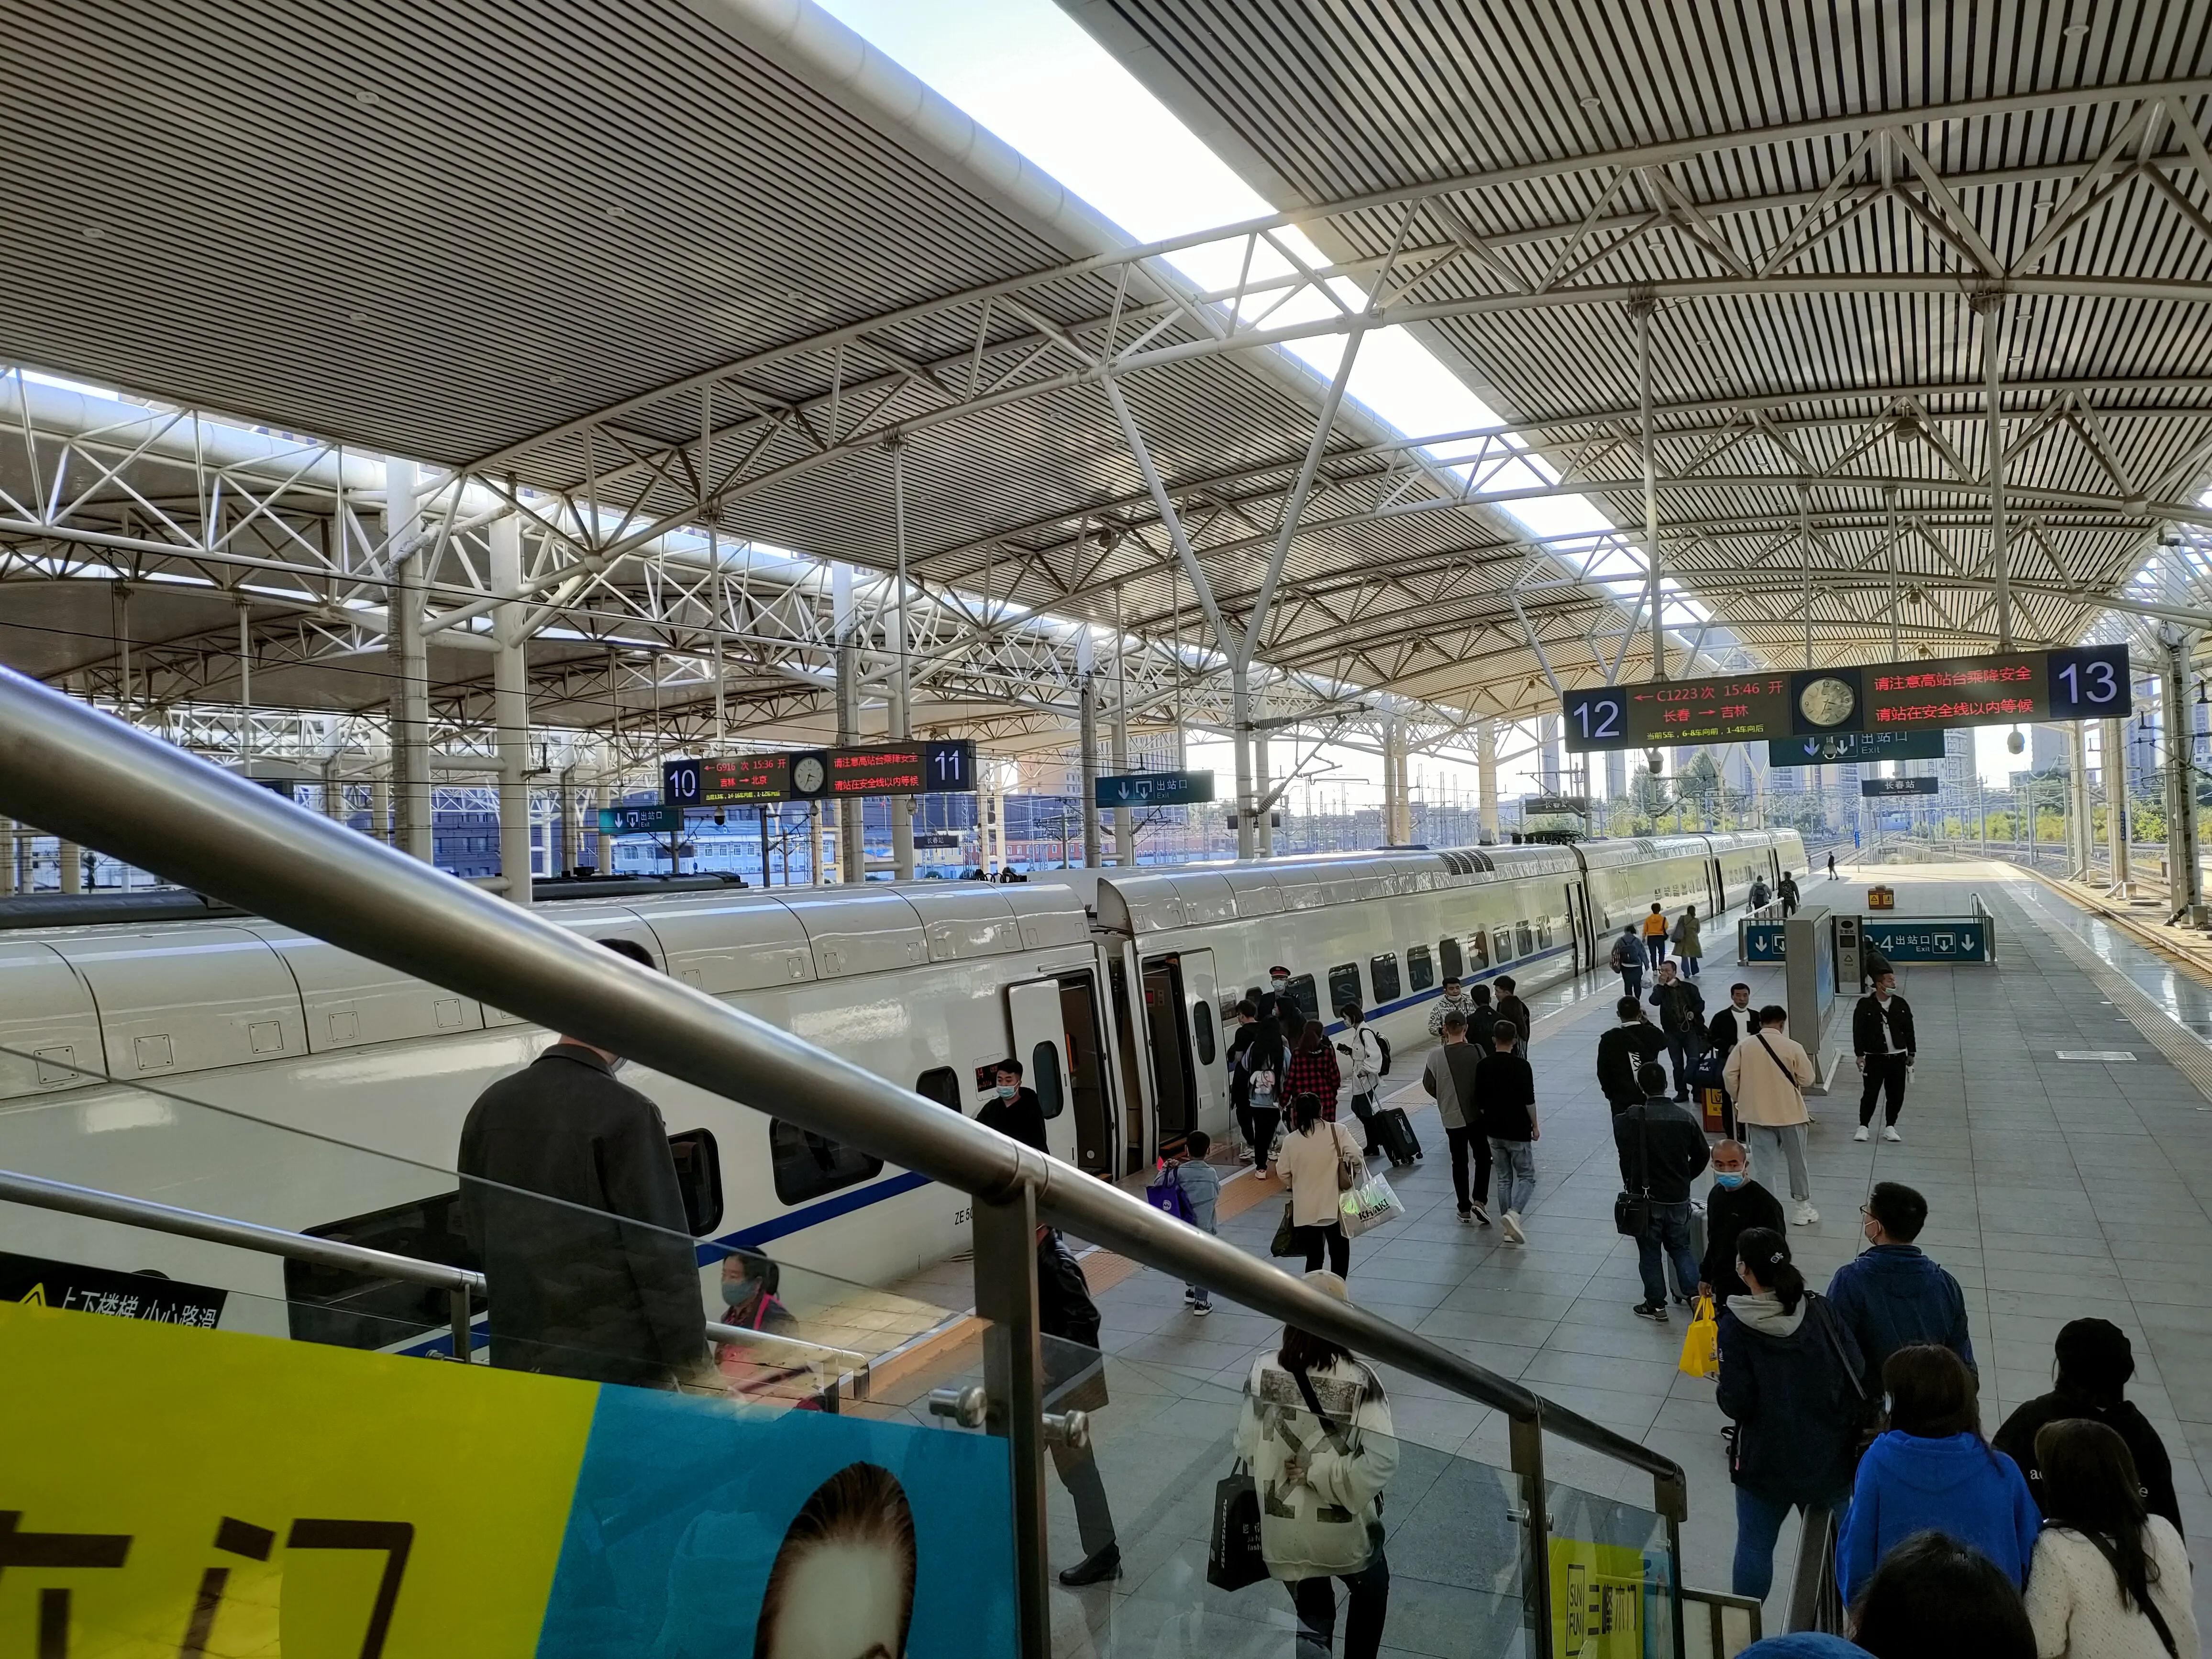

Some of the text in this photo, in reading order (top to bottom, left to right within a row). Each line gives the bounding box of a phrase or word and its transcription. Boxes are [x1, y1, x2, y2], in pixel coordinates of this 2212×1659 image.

[1874, 666, 2032, 691] 请注意高站台乘降安全
[2059, 661, 2117, 703] 13
[1724, 683, 1760, 697] 15:46
[1768, 680, 1783, 694] 开
[1663, 705, 1748, 722] 长春 吉林
[1875, 699, 2034, 722] 请站在安全线以内等候
[1573, 701, 1620, 739] 12
[1862, 731, 1907, 744] 出站口
[716, 763, 736, 772] G916
[741, 762, 749, 770] 次
[777, 759, 786, 769] 开
[834, 752, 918, 769] 请注意高站台乘降安全
[935, 750, 960, 781] 11
[670, 769, 696, 797] 10
[719, 775, 767, 787] 吉林 北京
[834, 775, 919, 791] 请站在安全线以内等候
[1157, 779, 1187, 791] 出站口
[1884, 780, 1915, 789] 长春站
[641, 811, 662, 820] 出站口
[1896, 935, 1930, 945] 出站口
[955, 1210, 964, 1226] ZE
